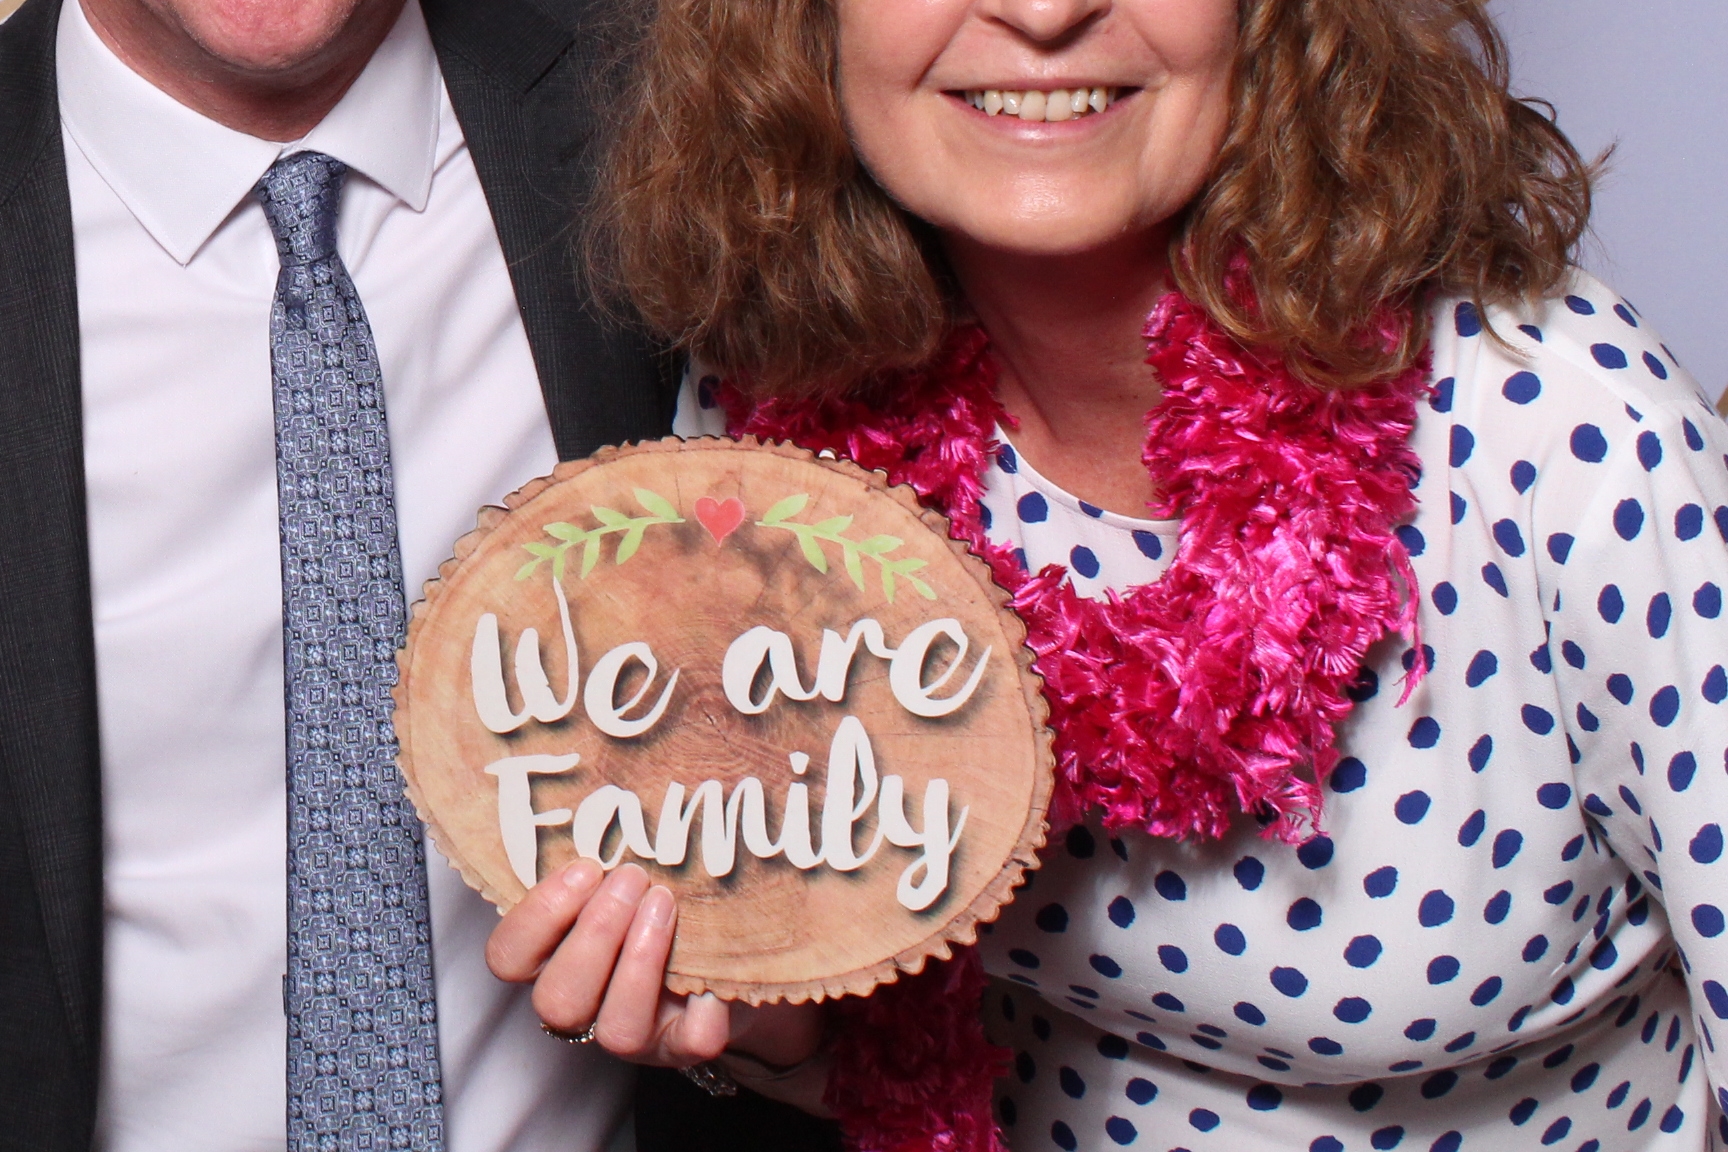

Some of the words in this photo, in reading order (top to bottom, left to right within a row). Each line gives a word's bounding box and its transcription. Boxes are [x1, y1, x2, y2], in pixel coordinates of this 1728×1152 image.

[471, 575, 680, 738] We
[722, 618, 992, 718] are
[484, 715, 969, 911] Family
